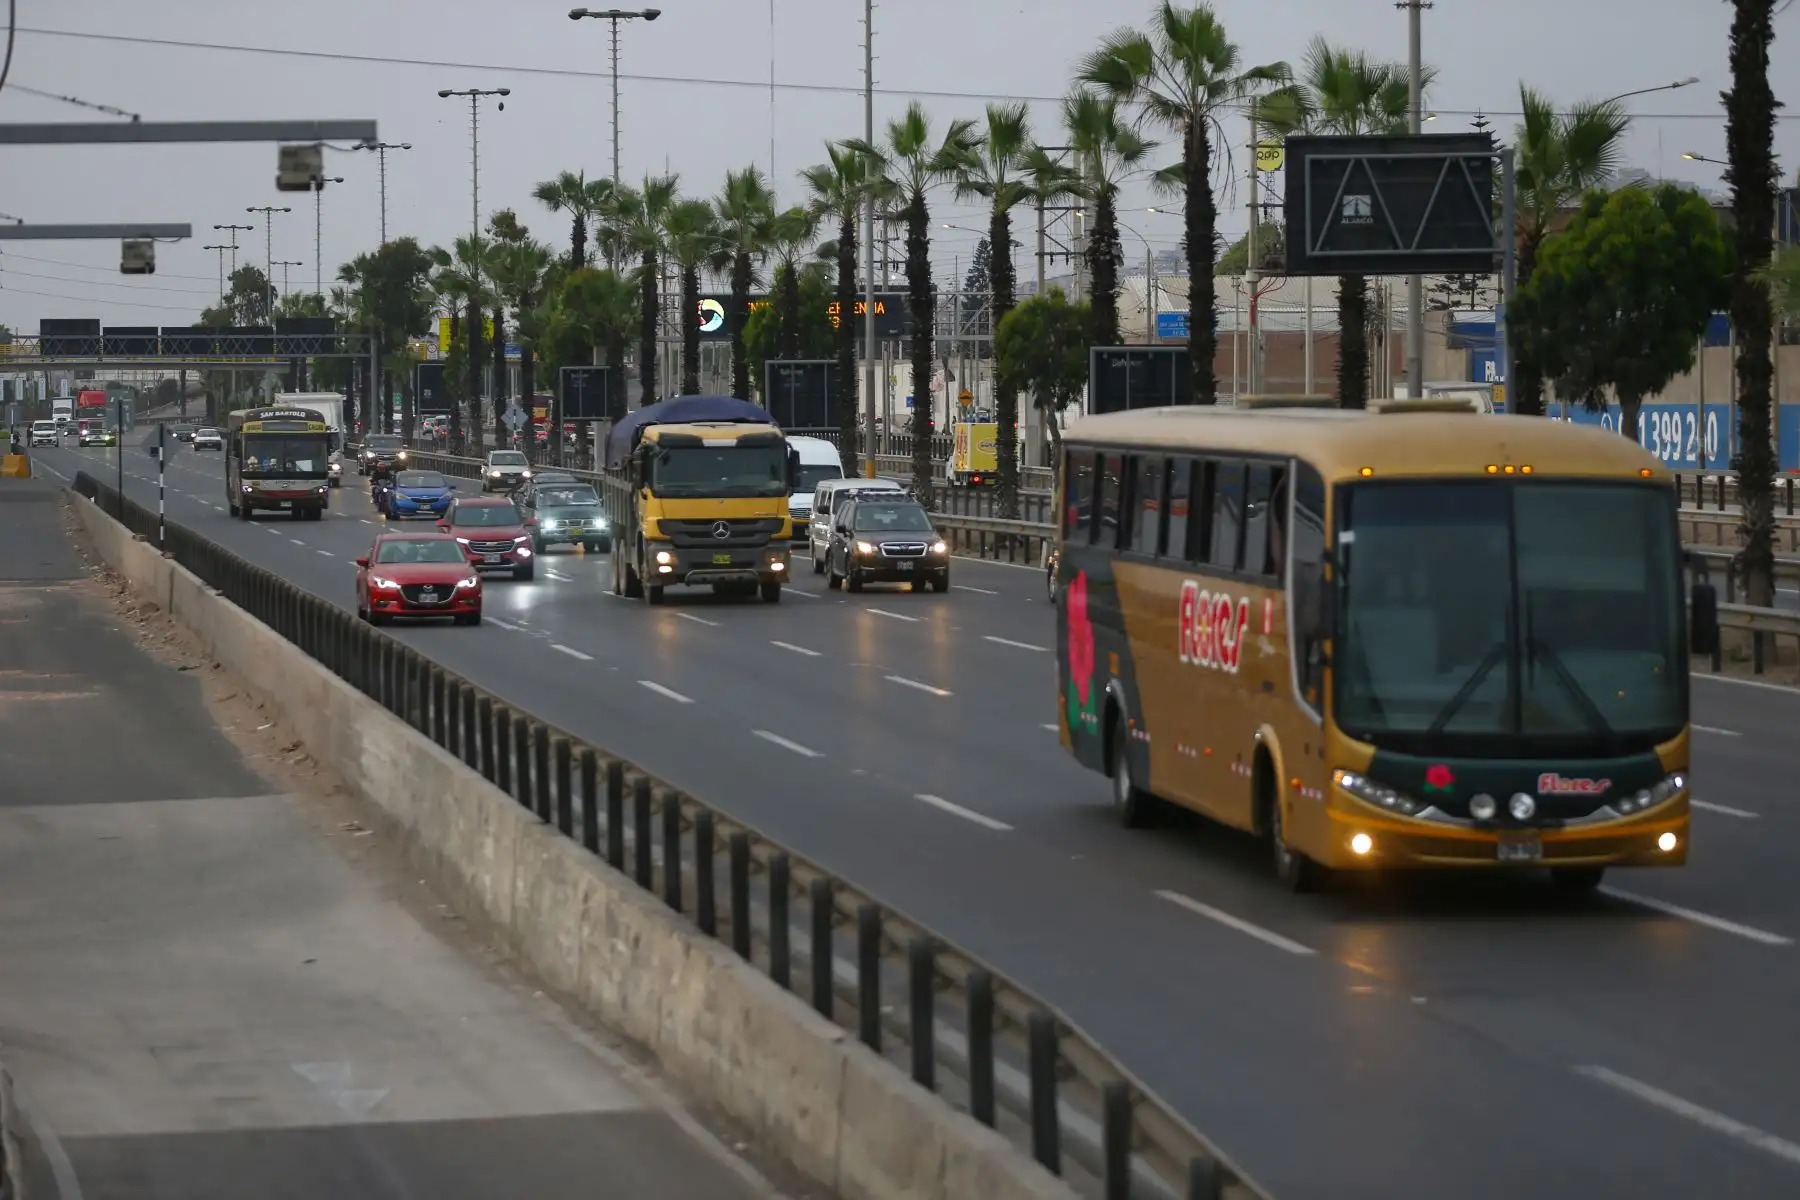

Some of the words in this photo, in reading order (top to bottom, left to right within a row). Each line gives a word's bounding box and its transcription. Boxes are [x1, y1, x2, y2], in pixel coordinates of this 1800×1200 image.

[1652, 411, 1682, 461] 399
[1180, 579, 1249, 674] Flores
[1537, 772, 1611, 795] Flores
